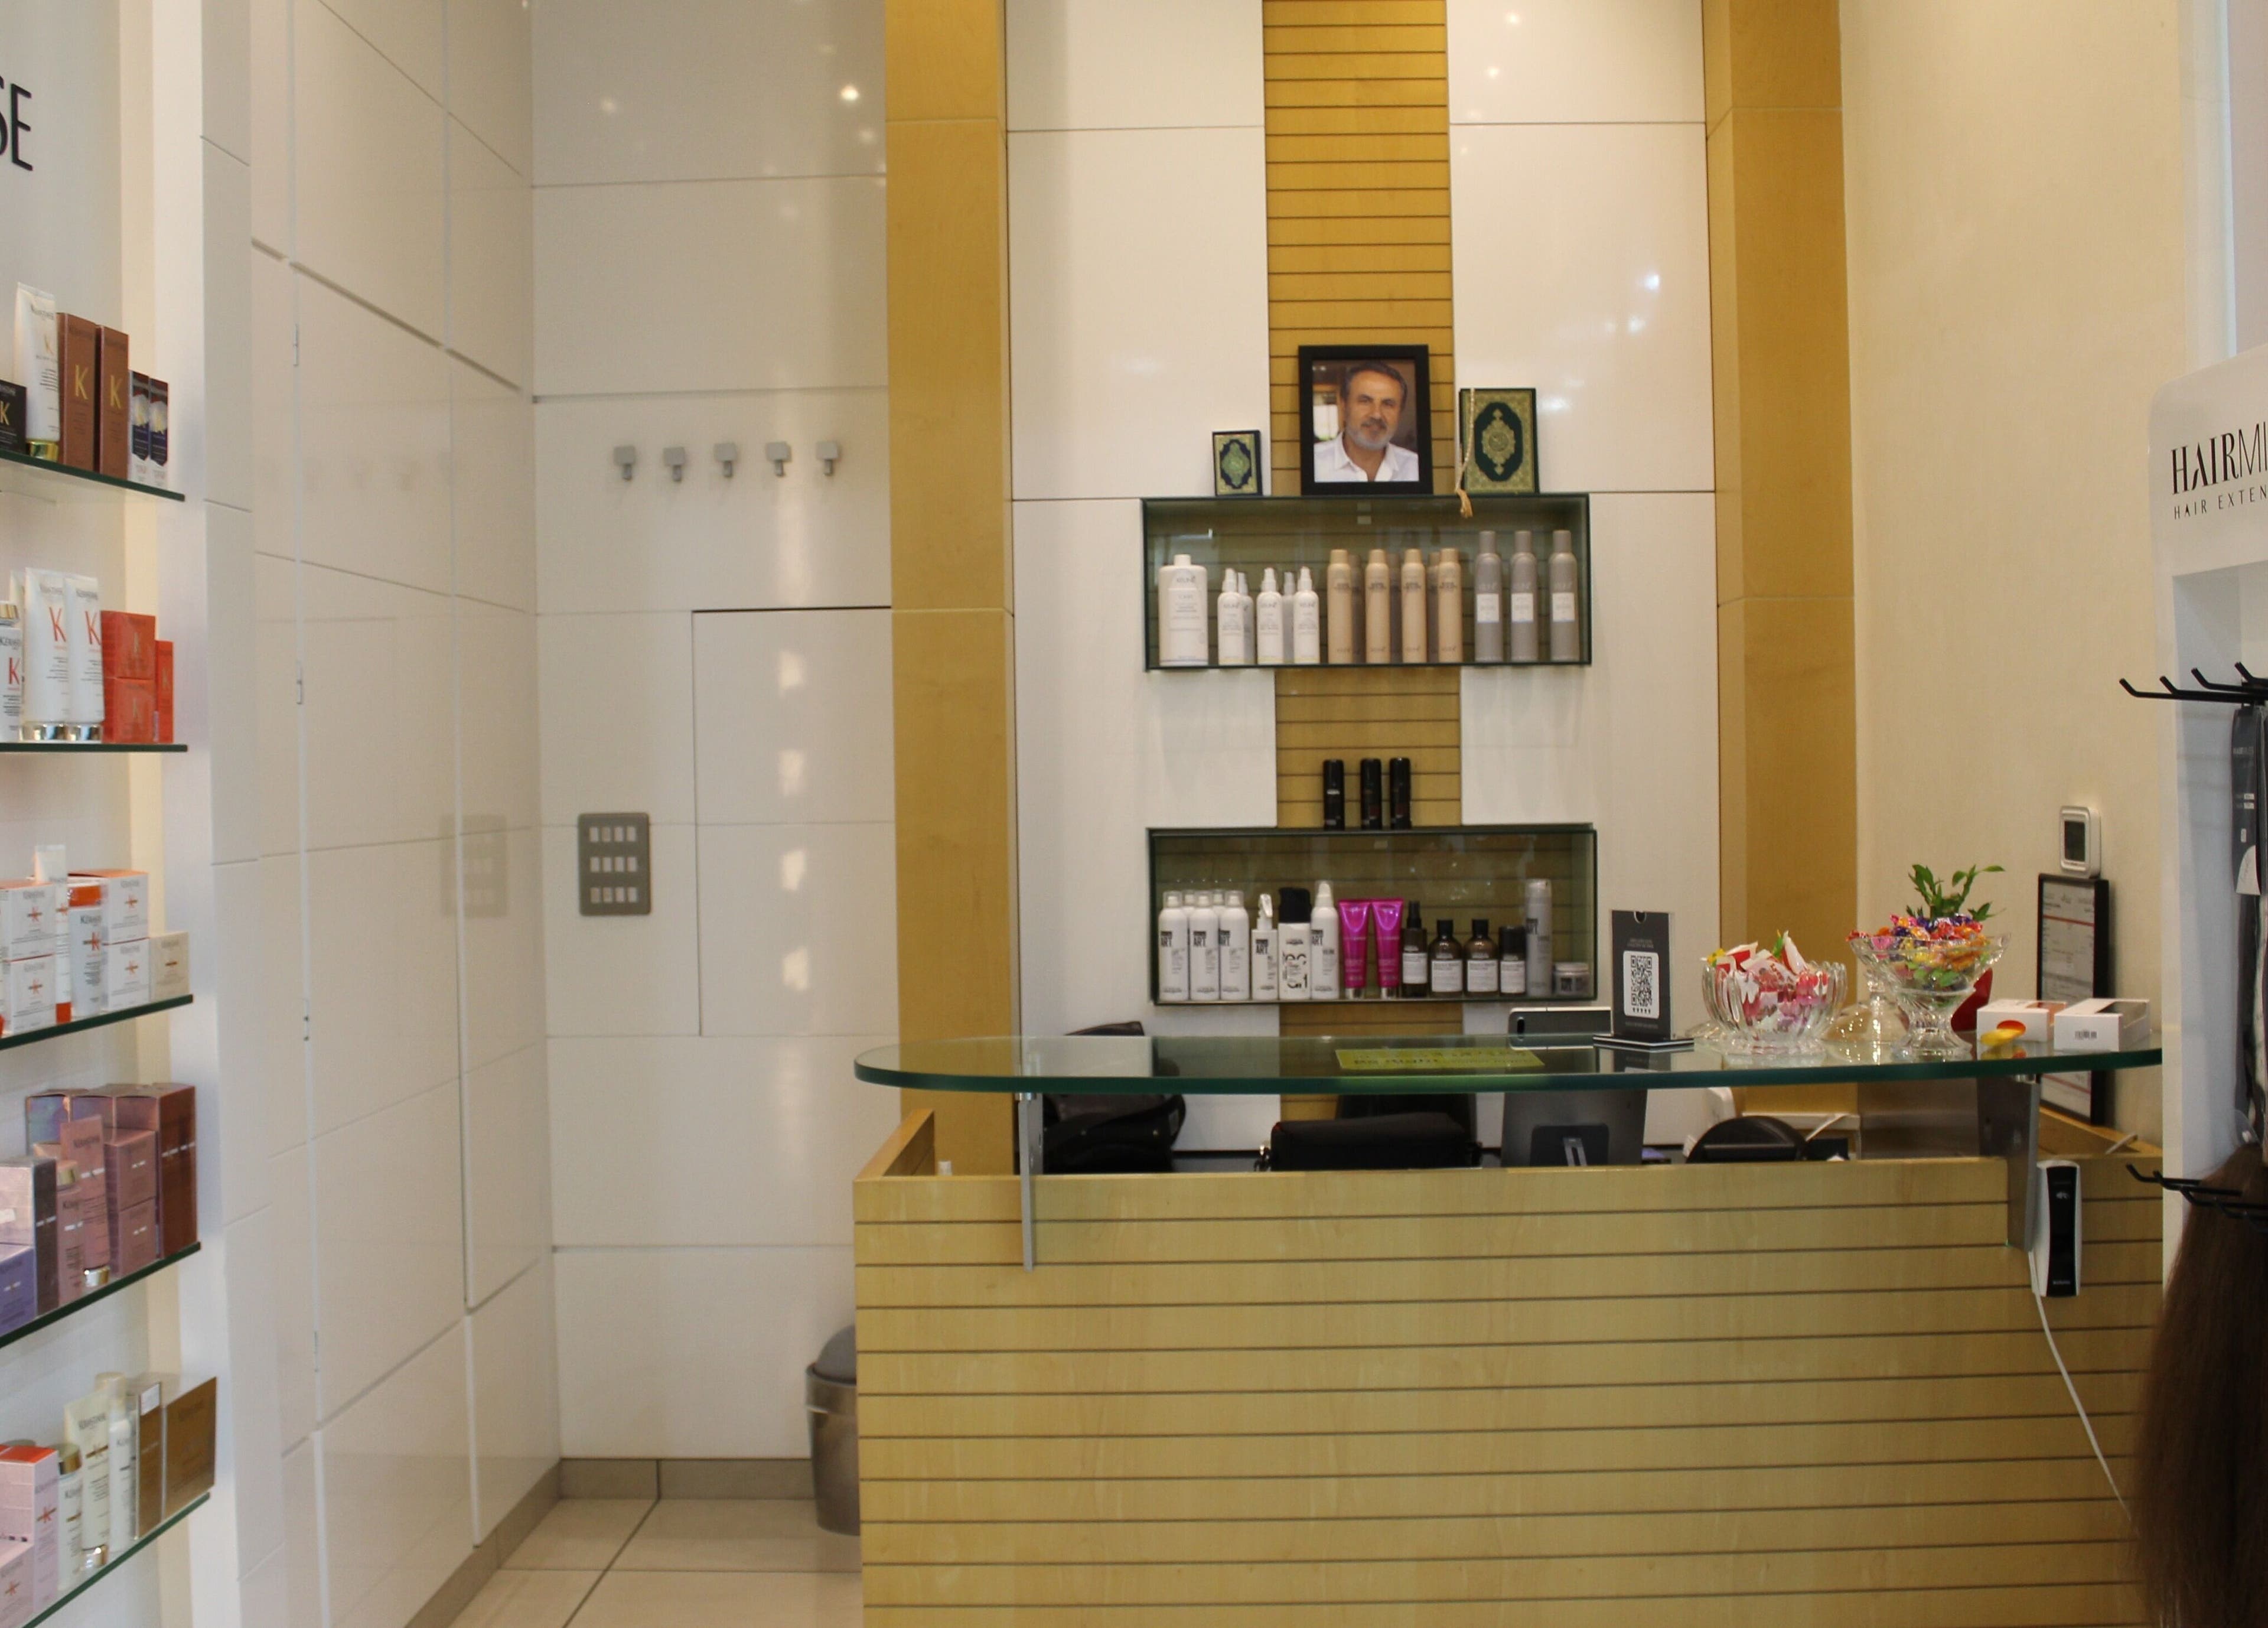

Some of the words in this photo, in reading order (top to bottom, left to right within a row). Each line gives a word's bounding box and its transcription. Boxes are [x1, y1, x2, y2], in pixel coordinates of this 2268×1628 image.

[75, 364, 88, 400] K
[110, 375, 123, 409] K
[2174, 499, 2207, 520] HAIR
[2218, 484, 2268, 510] EXTEN
[49, 606, 67, 643] K
[84, 610, 101, 645] K
[8, 656, 20, 685] K
[1256, 944, 1268, 955] ART
